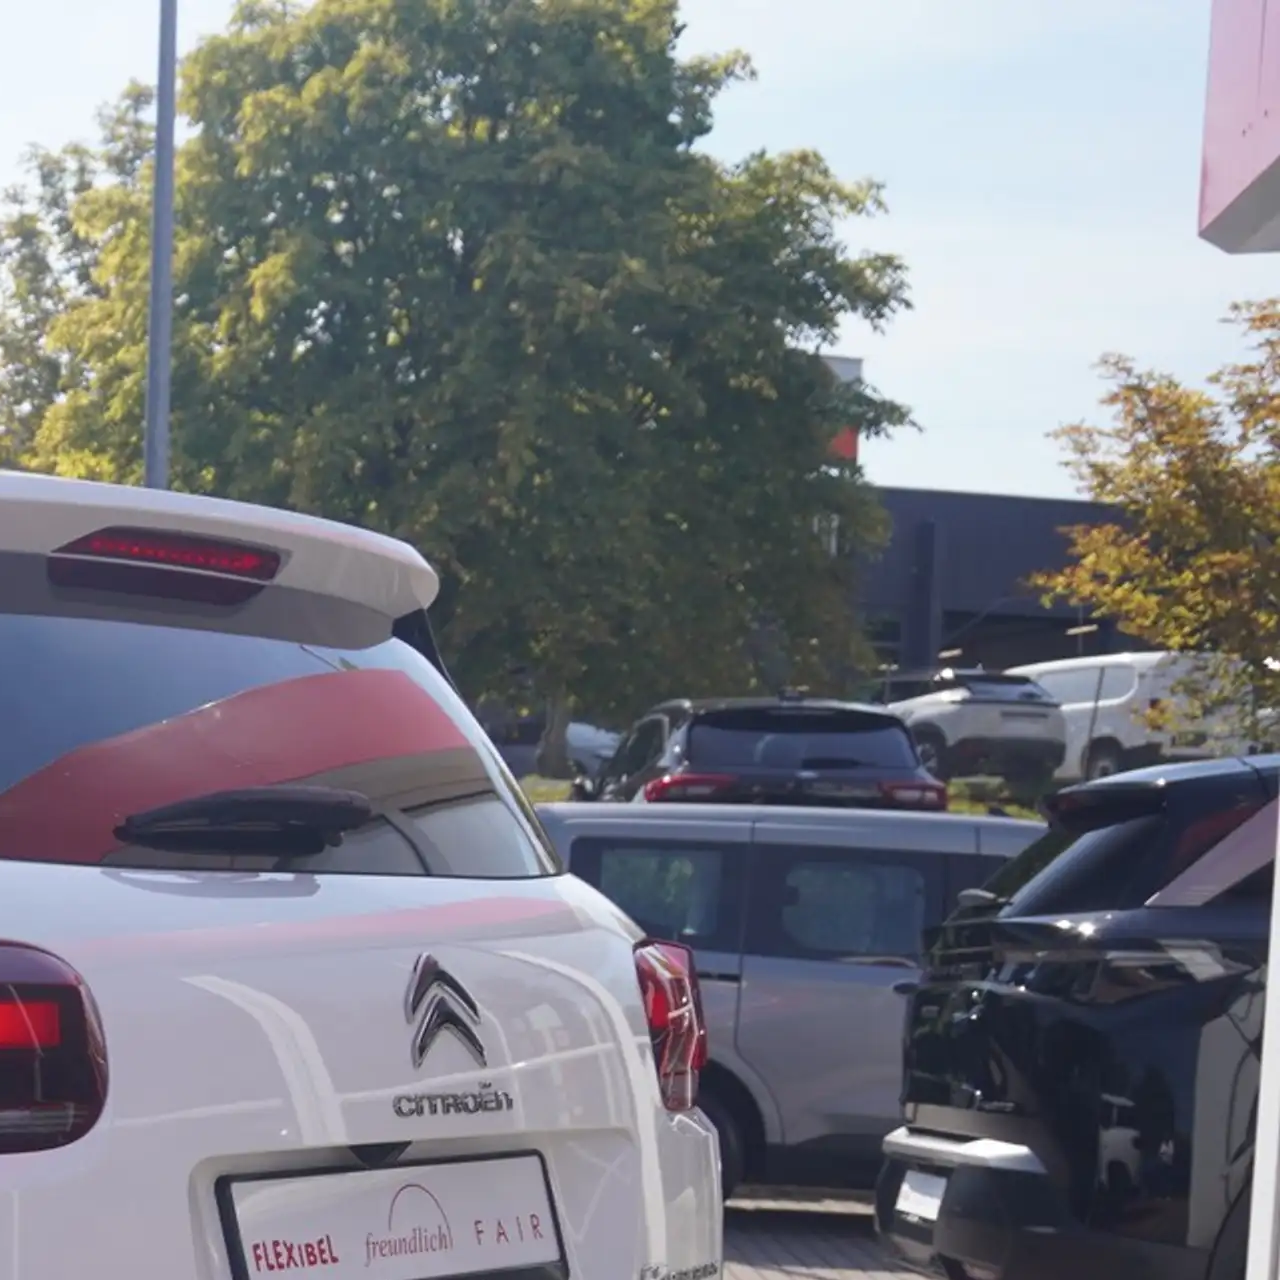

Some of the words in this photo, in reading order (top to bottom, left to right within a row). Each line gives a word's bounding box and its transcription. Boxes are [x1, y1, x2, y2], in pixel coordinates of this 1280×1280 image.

[252, 1233, 340, 1272] FLEXIBEL
[364, 1225, 449, 1268] freundlich
[474, 1213, 544, 1246] FAIR
